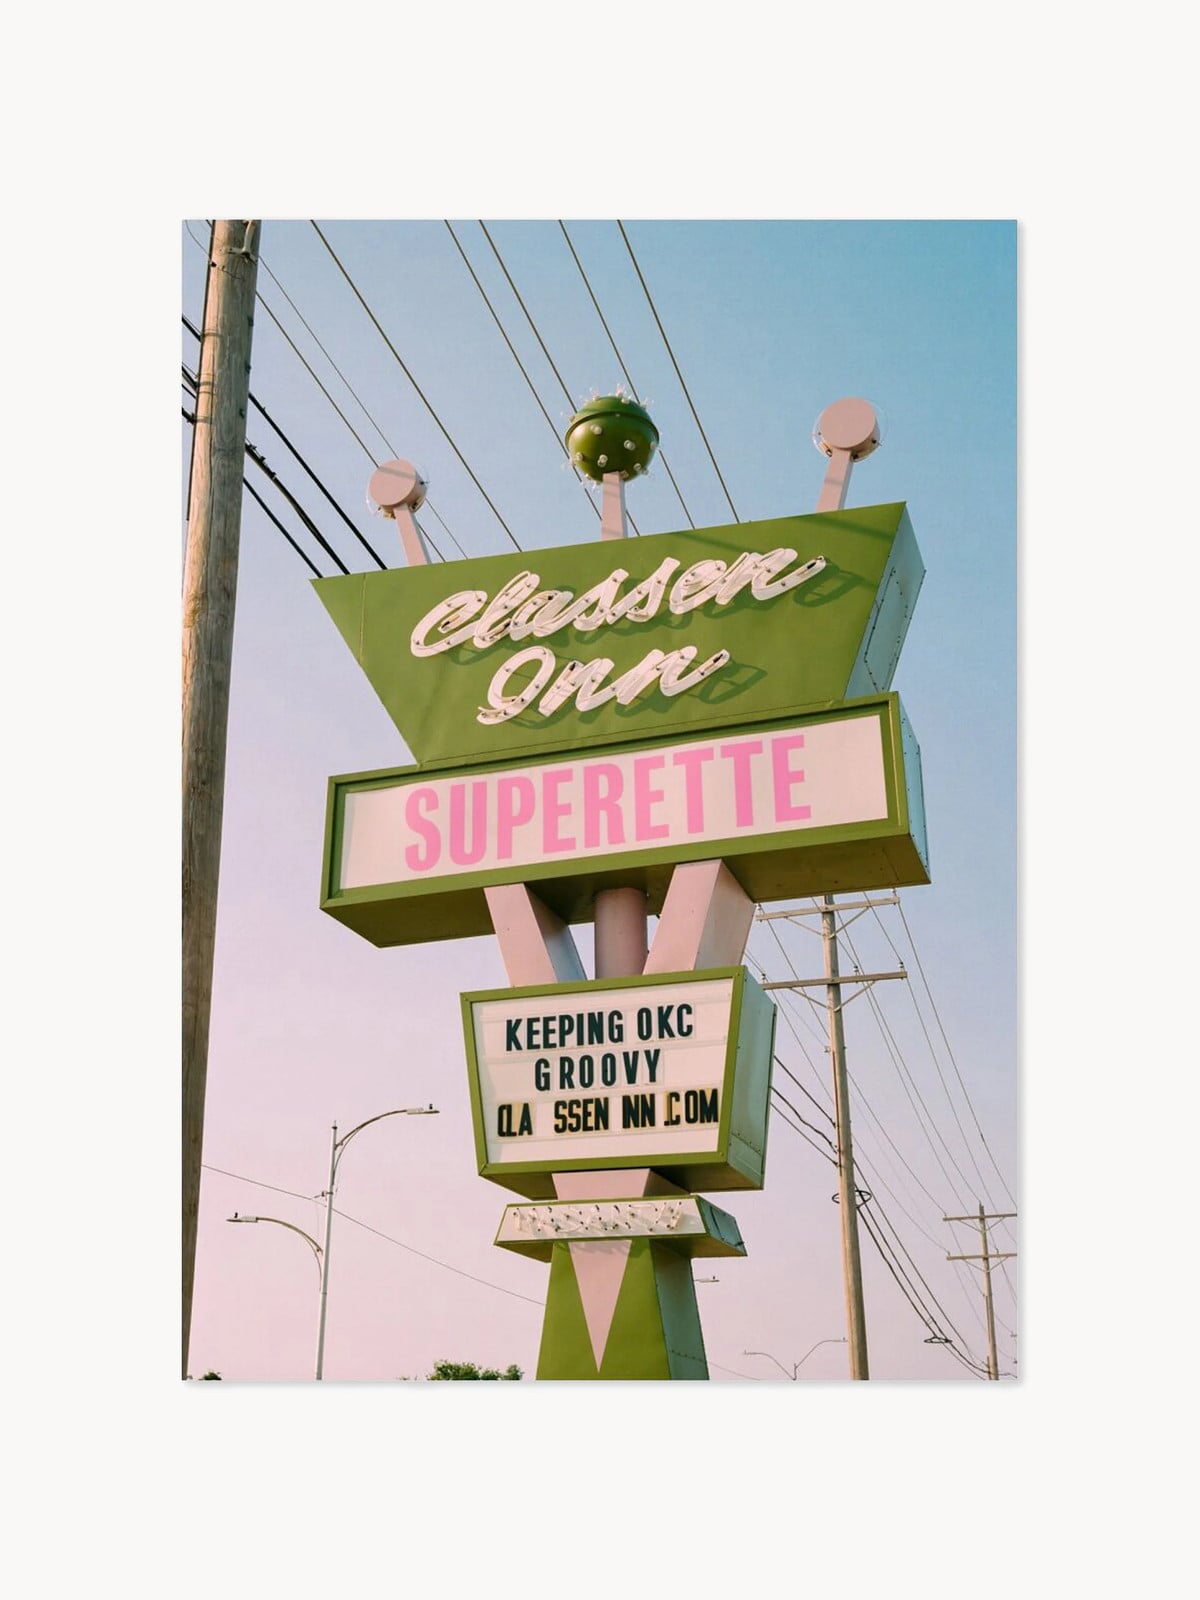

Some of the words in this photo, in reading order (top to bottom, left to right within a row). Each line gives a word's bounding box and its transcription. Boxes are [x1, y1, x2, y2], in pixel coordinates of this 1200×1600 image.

[410, 548, 827, 657] Classen
[476, 646, 730, 725] Inn
[404, 735, 812, 872] SUPERETTE
[505, 1010, 624, 1051] KEEPING
[637, 1003, 693, 1041] OKC
[534, 1048, 661, 1092] GROOVY
[554, 1097, 609, 1134] SSEN
